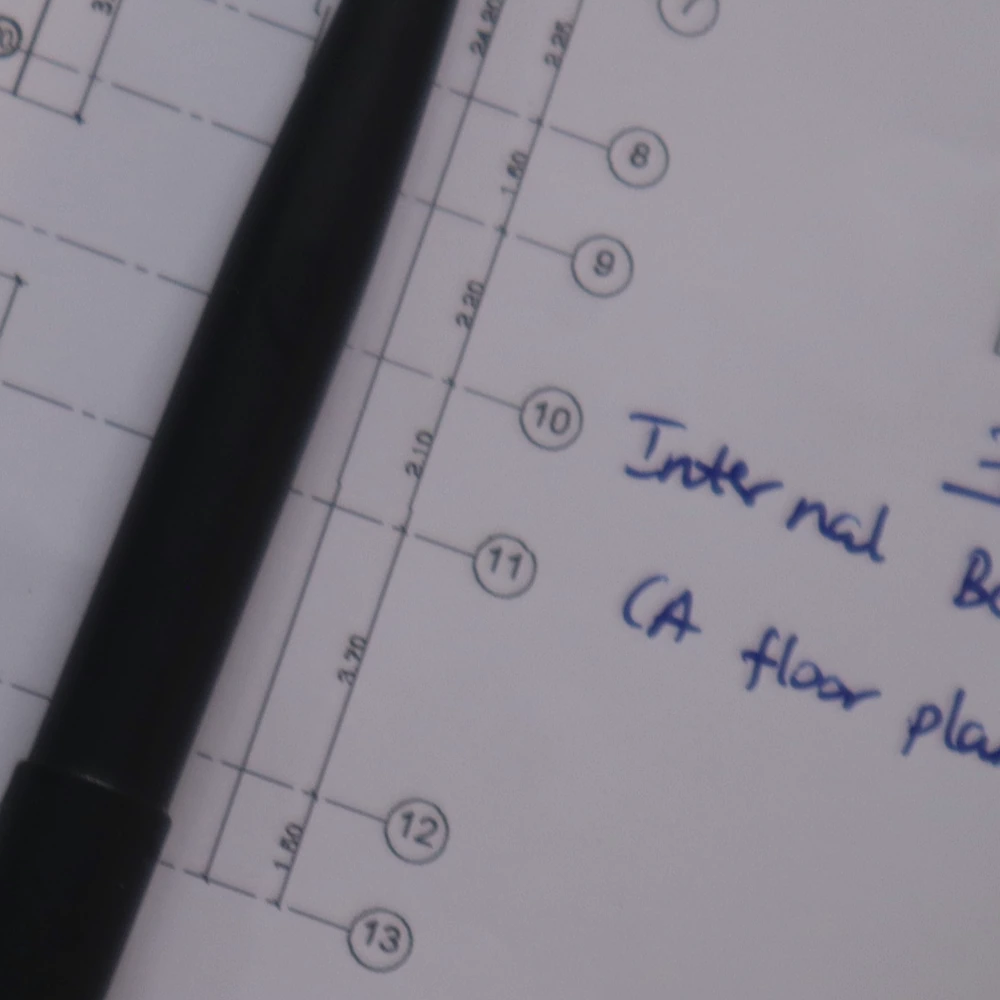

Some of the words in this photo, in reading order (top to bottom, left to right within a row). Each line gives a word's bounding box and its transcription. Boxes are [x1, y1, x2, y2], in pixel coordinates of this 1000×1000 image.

[629, 141, 651, 169] 8
[593, 248, 616, 278] 9
[535, 401, 571, 437] 10
[404, 429, 435, 478] 2.10
[487, 545, 523, 580] 11
[740, 625, 882, 711] floor
[400, 809, 439, 849] 12
[363, 918, 401, 953] 13
